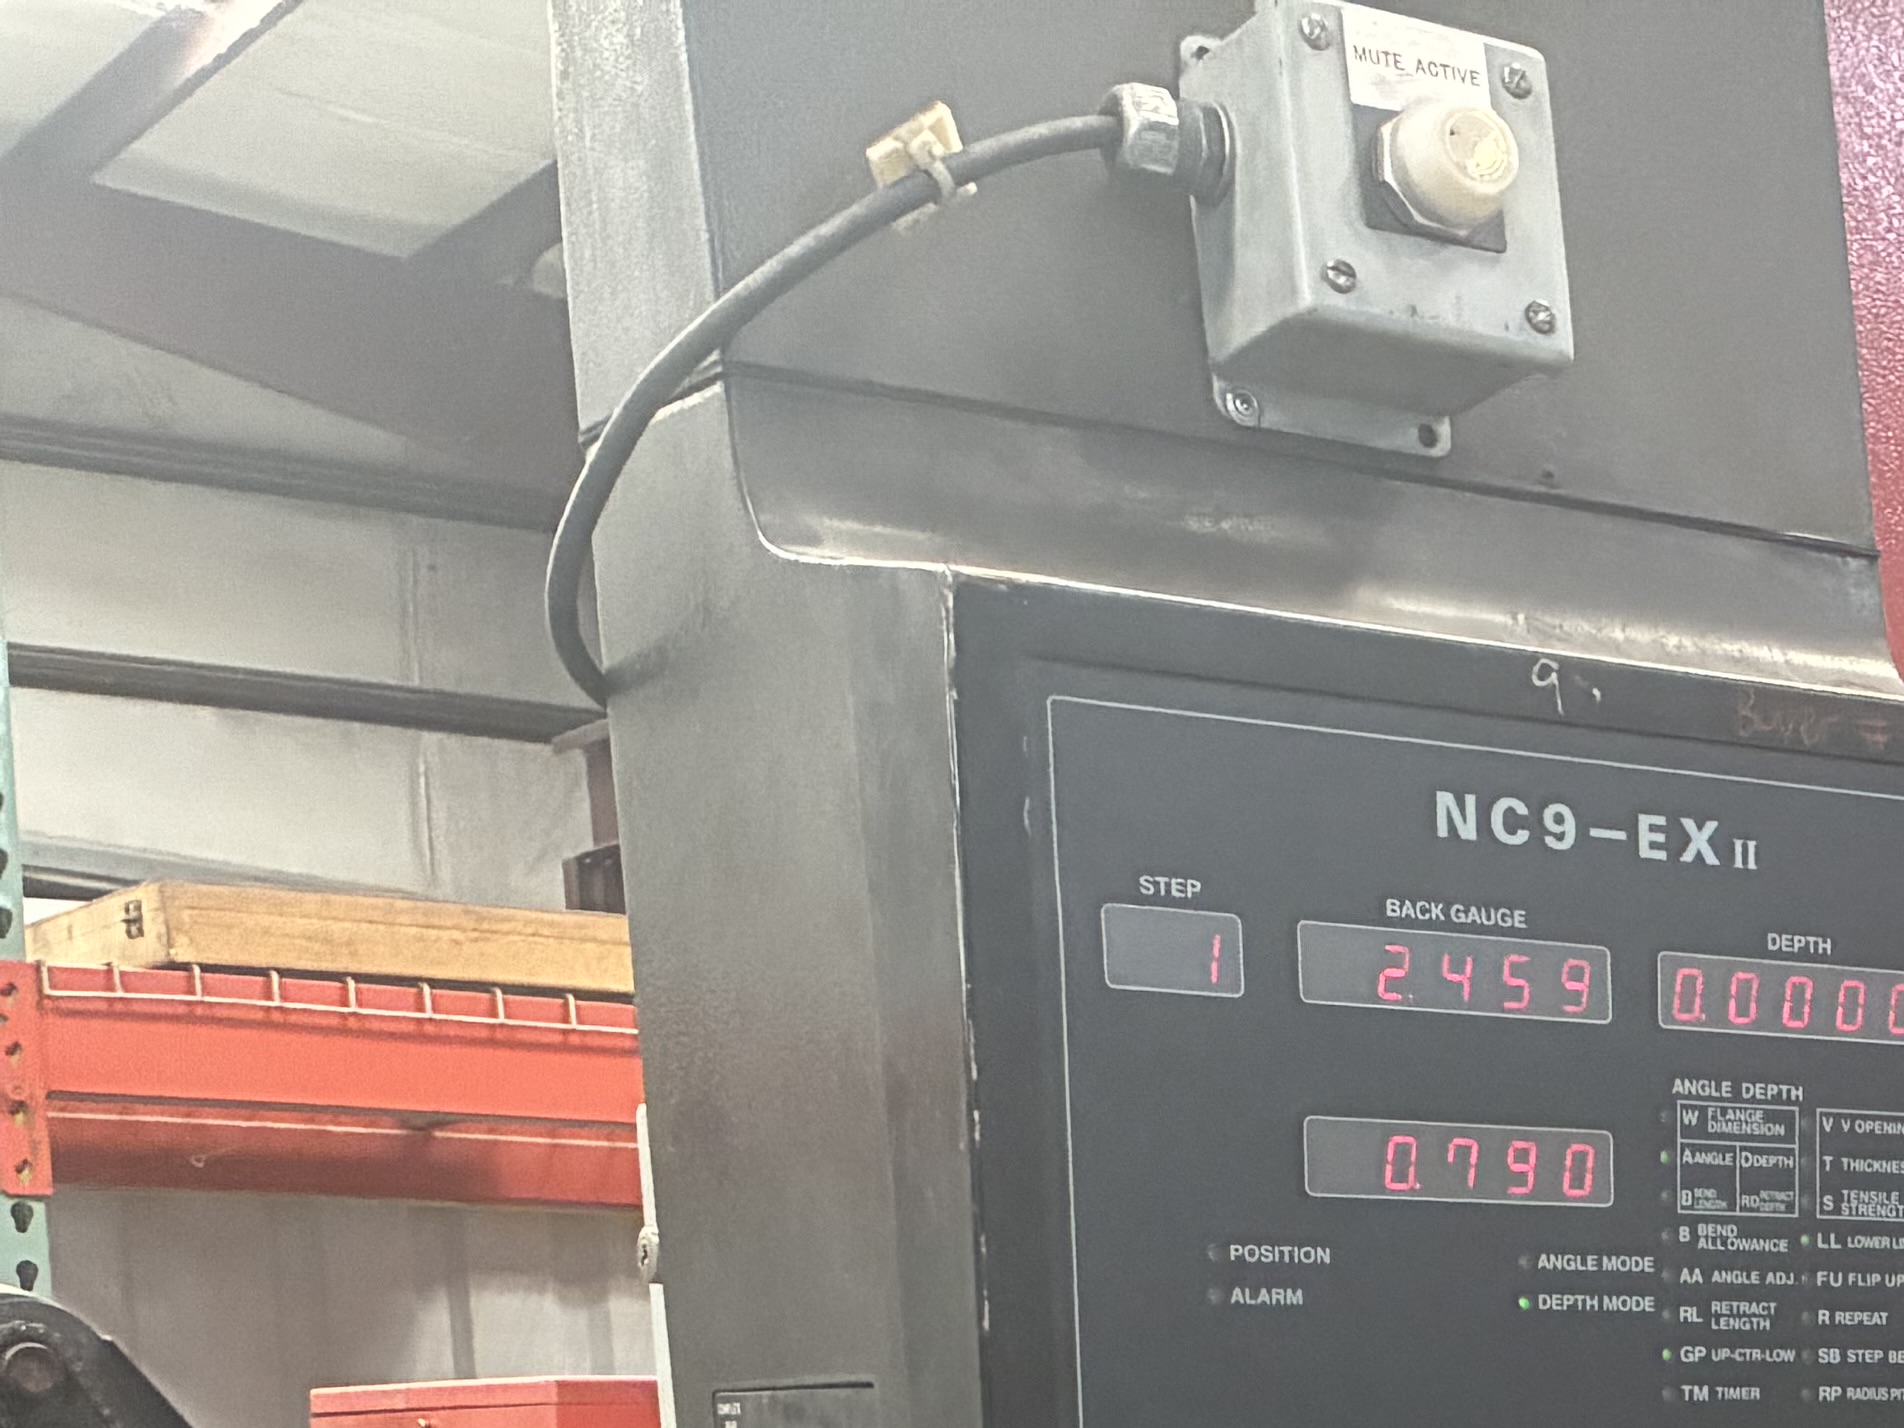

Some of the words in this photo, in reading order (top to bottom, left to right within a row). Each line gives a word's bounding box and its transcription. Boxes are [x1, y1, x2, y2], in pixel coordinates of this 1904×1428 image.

[1353, 44, 1405, 71] MUTE
[1415, 58, 1481, 87] ACTIVE
[1436, 791, 1721, 866] NC9-EX
[1138, 874, 1202, 898] STEP
[1385, 898, 1446, 922] BACK
[1450, 904, 1528, 929] GAUGE
[1767, 933, 1833, 955] DEPTH
[1210, 934, 1221, 984] 1
[1672, 1078, 1733, 1098] ANGLE
[1742, 1083, 1803, 1101] DEPTH
[1708, 1107, 1764, 1123] FLANGE
[1708, 1121, 1786, 1136] DIMENSION
[1841, 1189, 1900, 1205] TENSILE
[1698, 1223, 1738, 1238] BEND
[1698, 1237, 1788, 1252] ALLOWANCE
[1847, 1235, 1891, 1250] LOWER
[1230, 1244, 1331, 1265] POSITION
[1538, 1254, 1599, 1272] ANGLE
[1602, 1254, 1655, 1273] MODE
[1711, 1270, 1760, 1285] ANGLE
[1817, 1271, 1843, 1287] FU
[1848, 1272, 1881, 1286] FLIP
[1230, 1287, 1303, 1306] ALARM
[1538, 1294, 1599, 1312] DEPTH
[1602, 1295, 1655, 1312] MODE
[1679, 1306, 1703, 1322] RL
[1711, 1301, 1777, 1316] RETRACT
[1711, 1317, 1770, 1330] LENGTH
[1835, 1311, 1888, 1325] REPEAT
[1680, 1346, 1706, 1362] GP
[1711, 1348, 1796, 1363] UP-CTR-LOW
[1818, 1348, 1841, 1364] SB
[1847, 1349, 1883, 1363] STEP
[1680, 1385, 1709, 1401] TM
[1846, 1387, 1888, 1401] RADIUS
